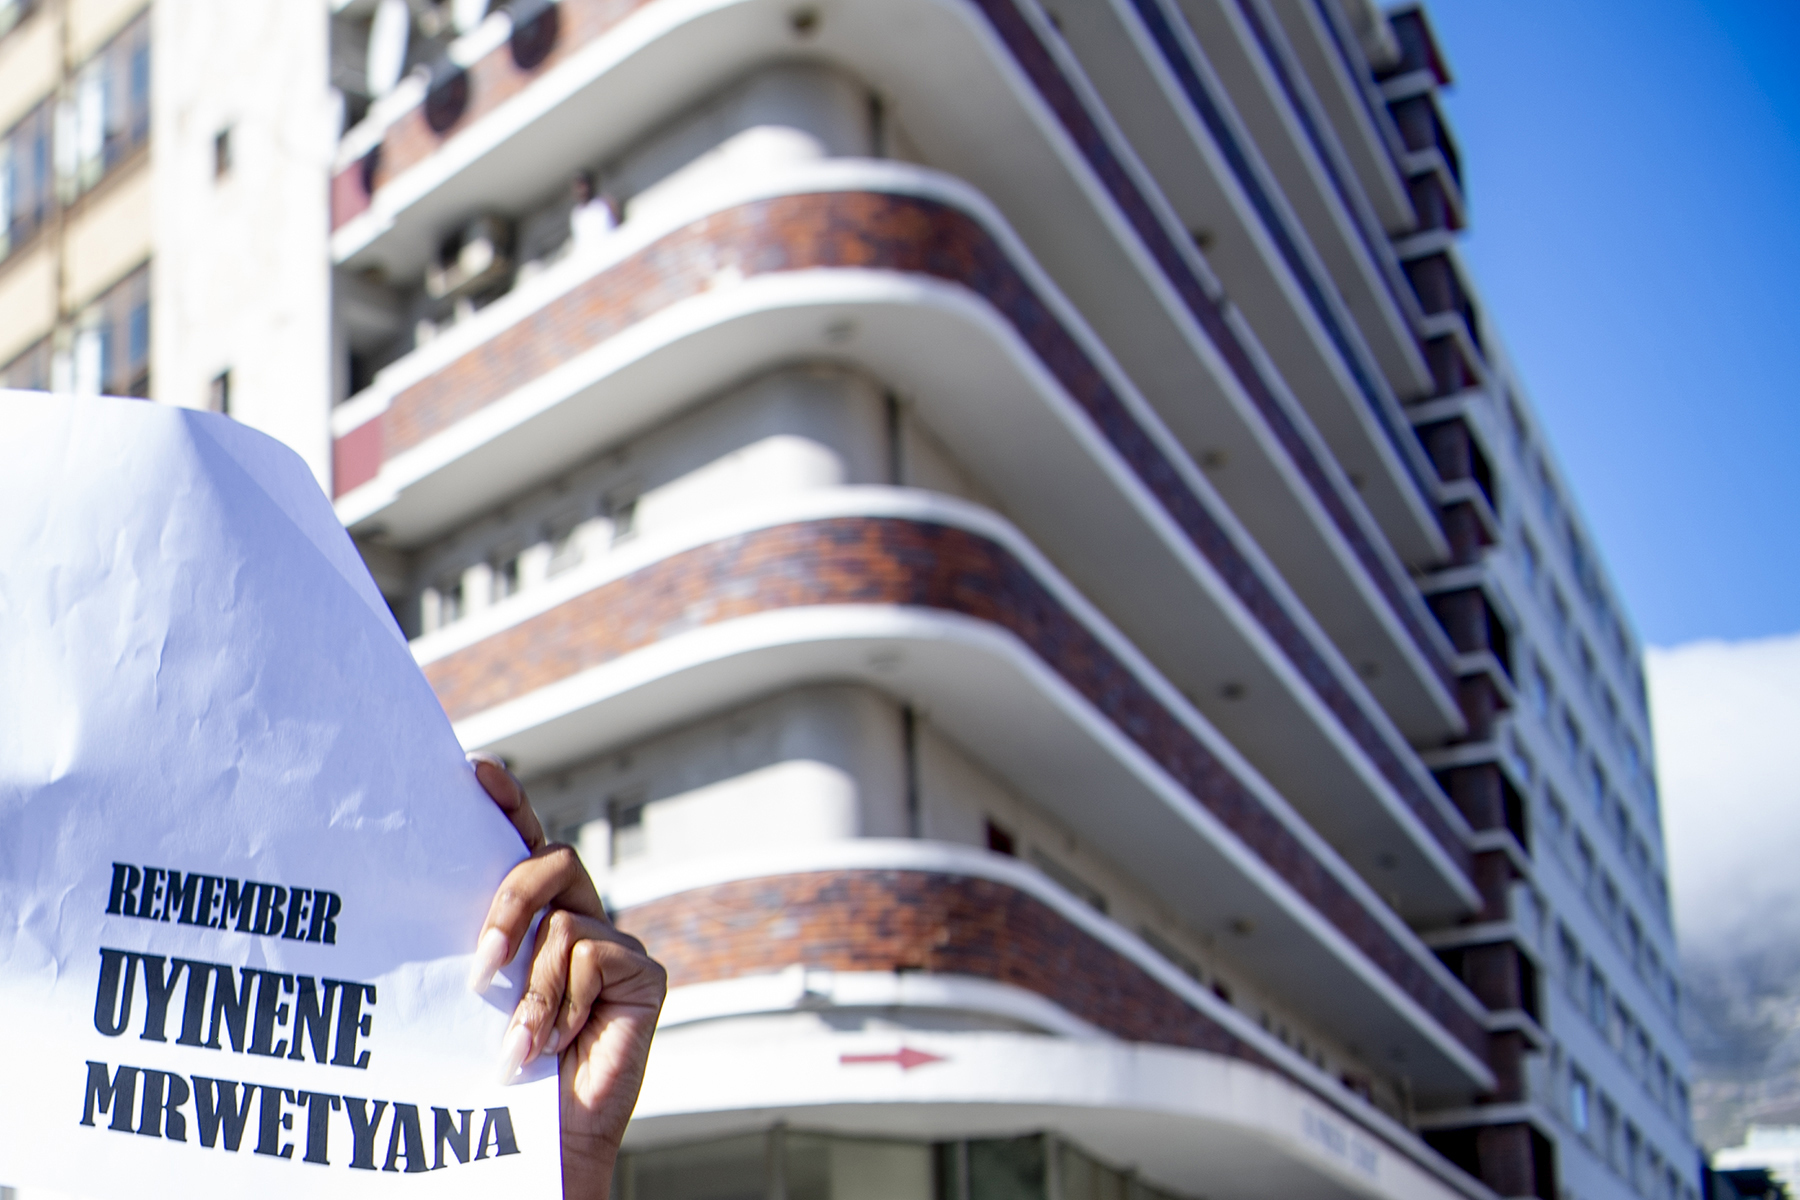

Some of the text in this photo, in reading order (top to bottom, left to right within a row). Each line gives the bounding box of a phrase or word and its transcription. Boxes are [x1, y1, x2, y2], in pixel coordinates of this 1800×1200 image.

[105, 861, 342, 945] REMEMBER
[93, 947, 377, 1070] UYINENE
[79, 1060, 521, 1173] MRWETYANA
